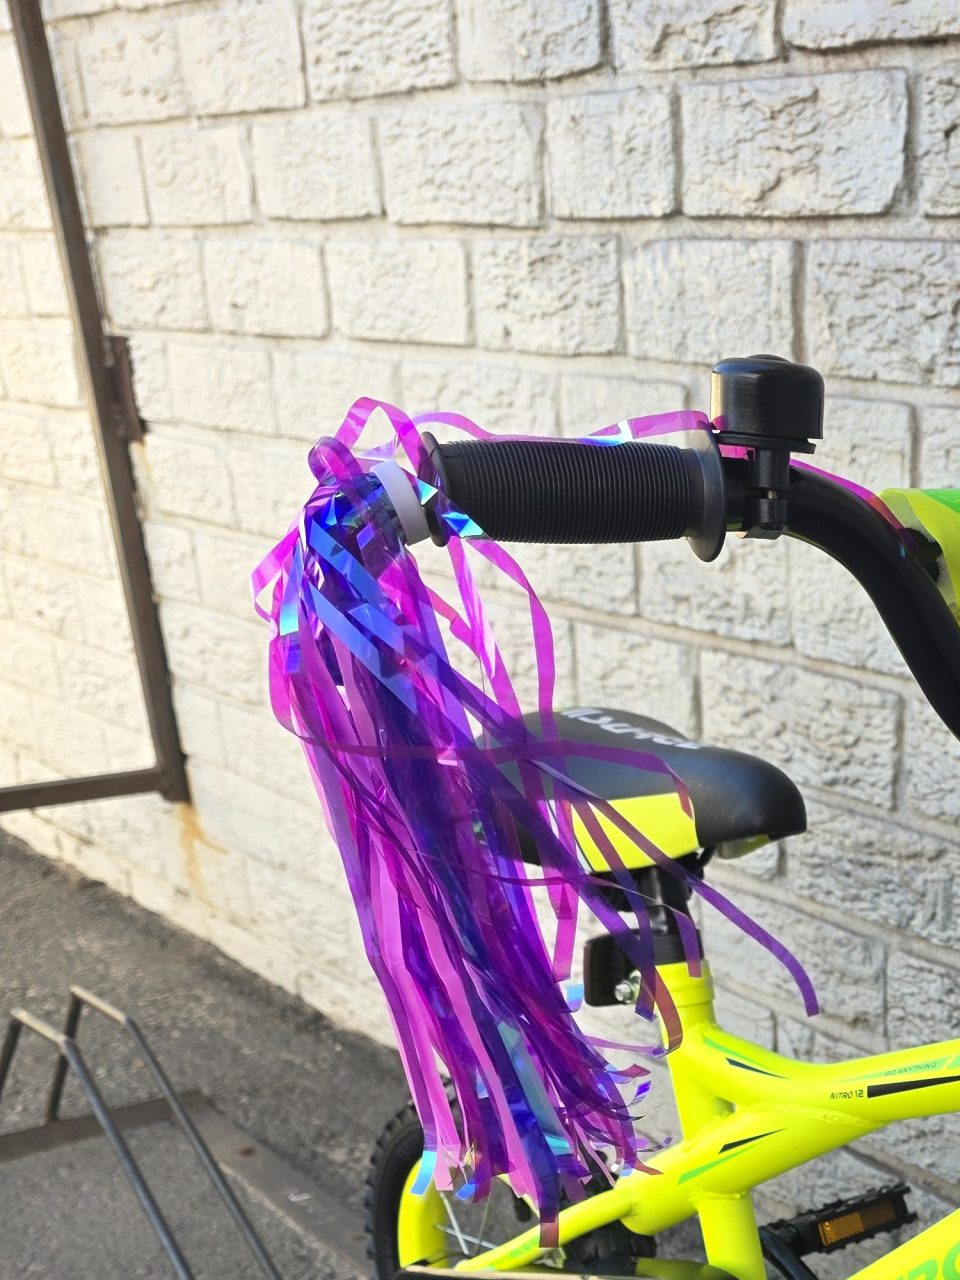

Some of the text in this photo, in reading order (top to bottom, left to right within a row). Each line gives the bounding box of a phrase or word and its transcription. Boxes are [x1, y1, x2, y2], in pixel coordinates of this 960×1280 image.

[897, 1062, 937, 1074] ANYTHING
[830, 1090, 864, 1100] NITRO 12
